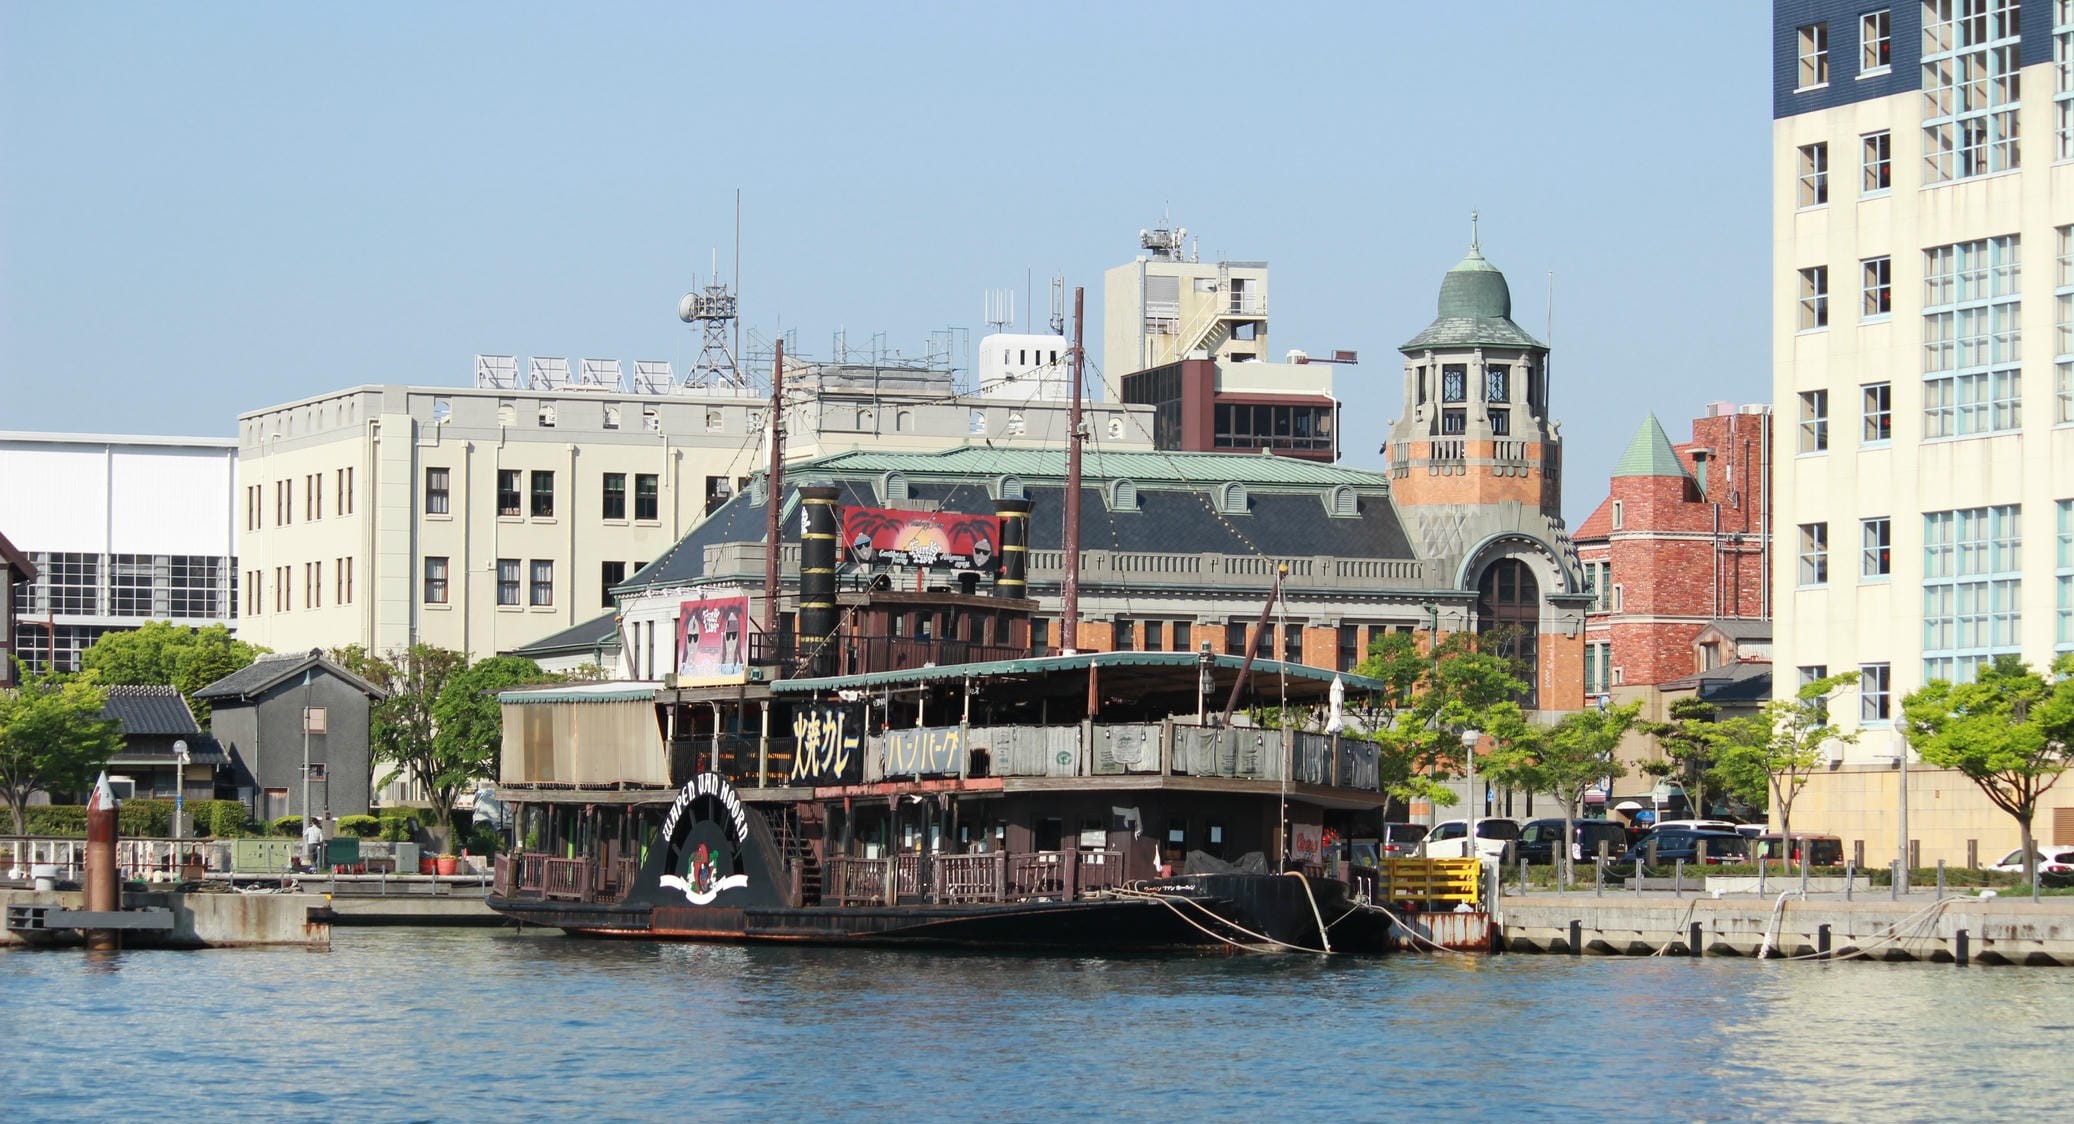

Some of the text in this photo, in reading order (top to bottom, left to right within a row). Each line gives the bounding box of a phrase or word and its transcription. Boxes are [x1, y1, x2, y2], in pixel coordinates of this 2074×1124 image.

[791, 710, 859, 781] 焼カレー
[888, 731, 958, 771] ハンバーグ
